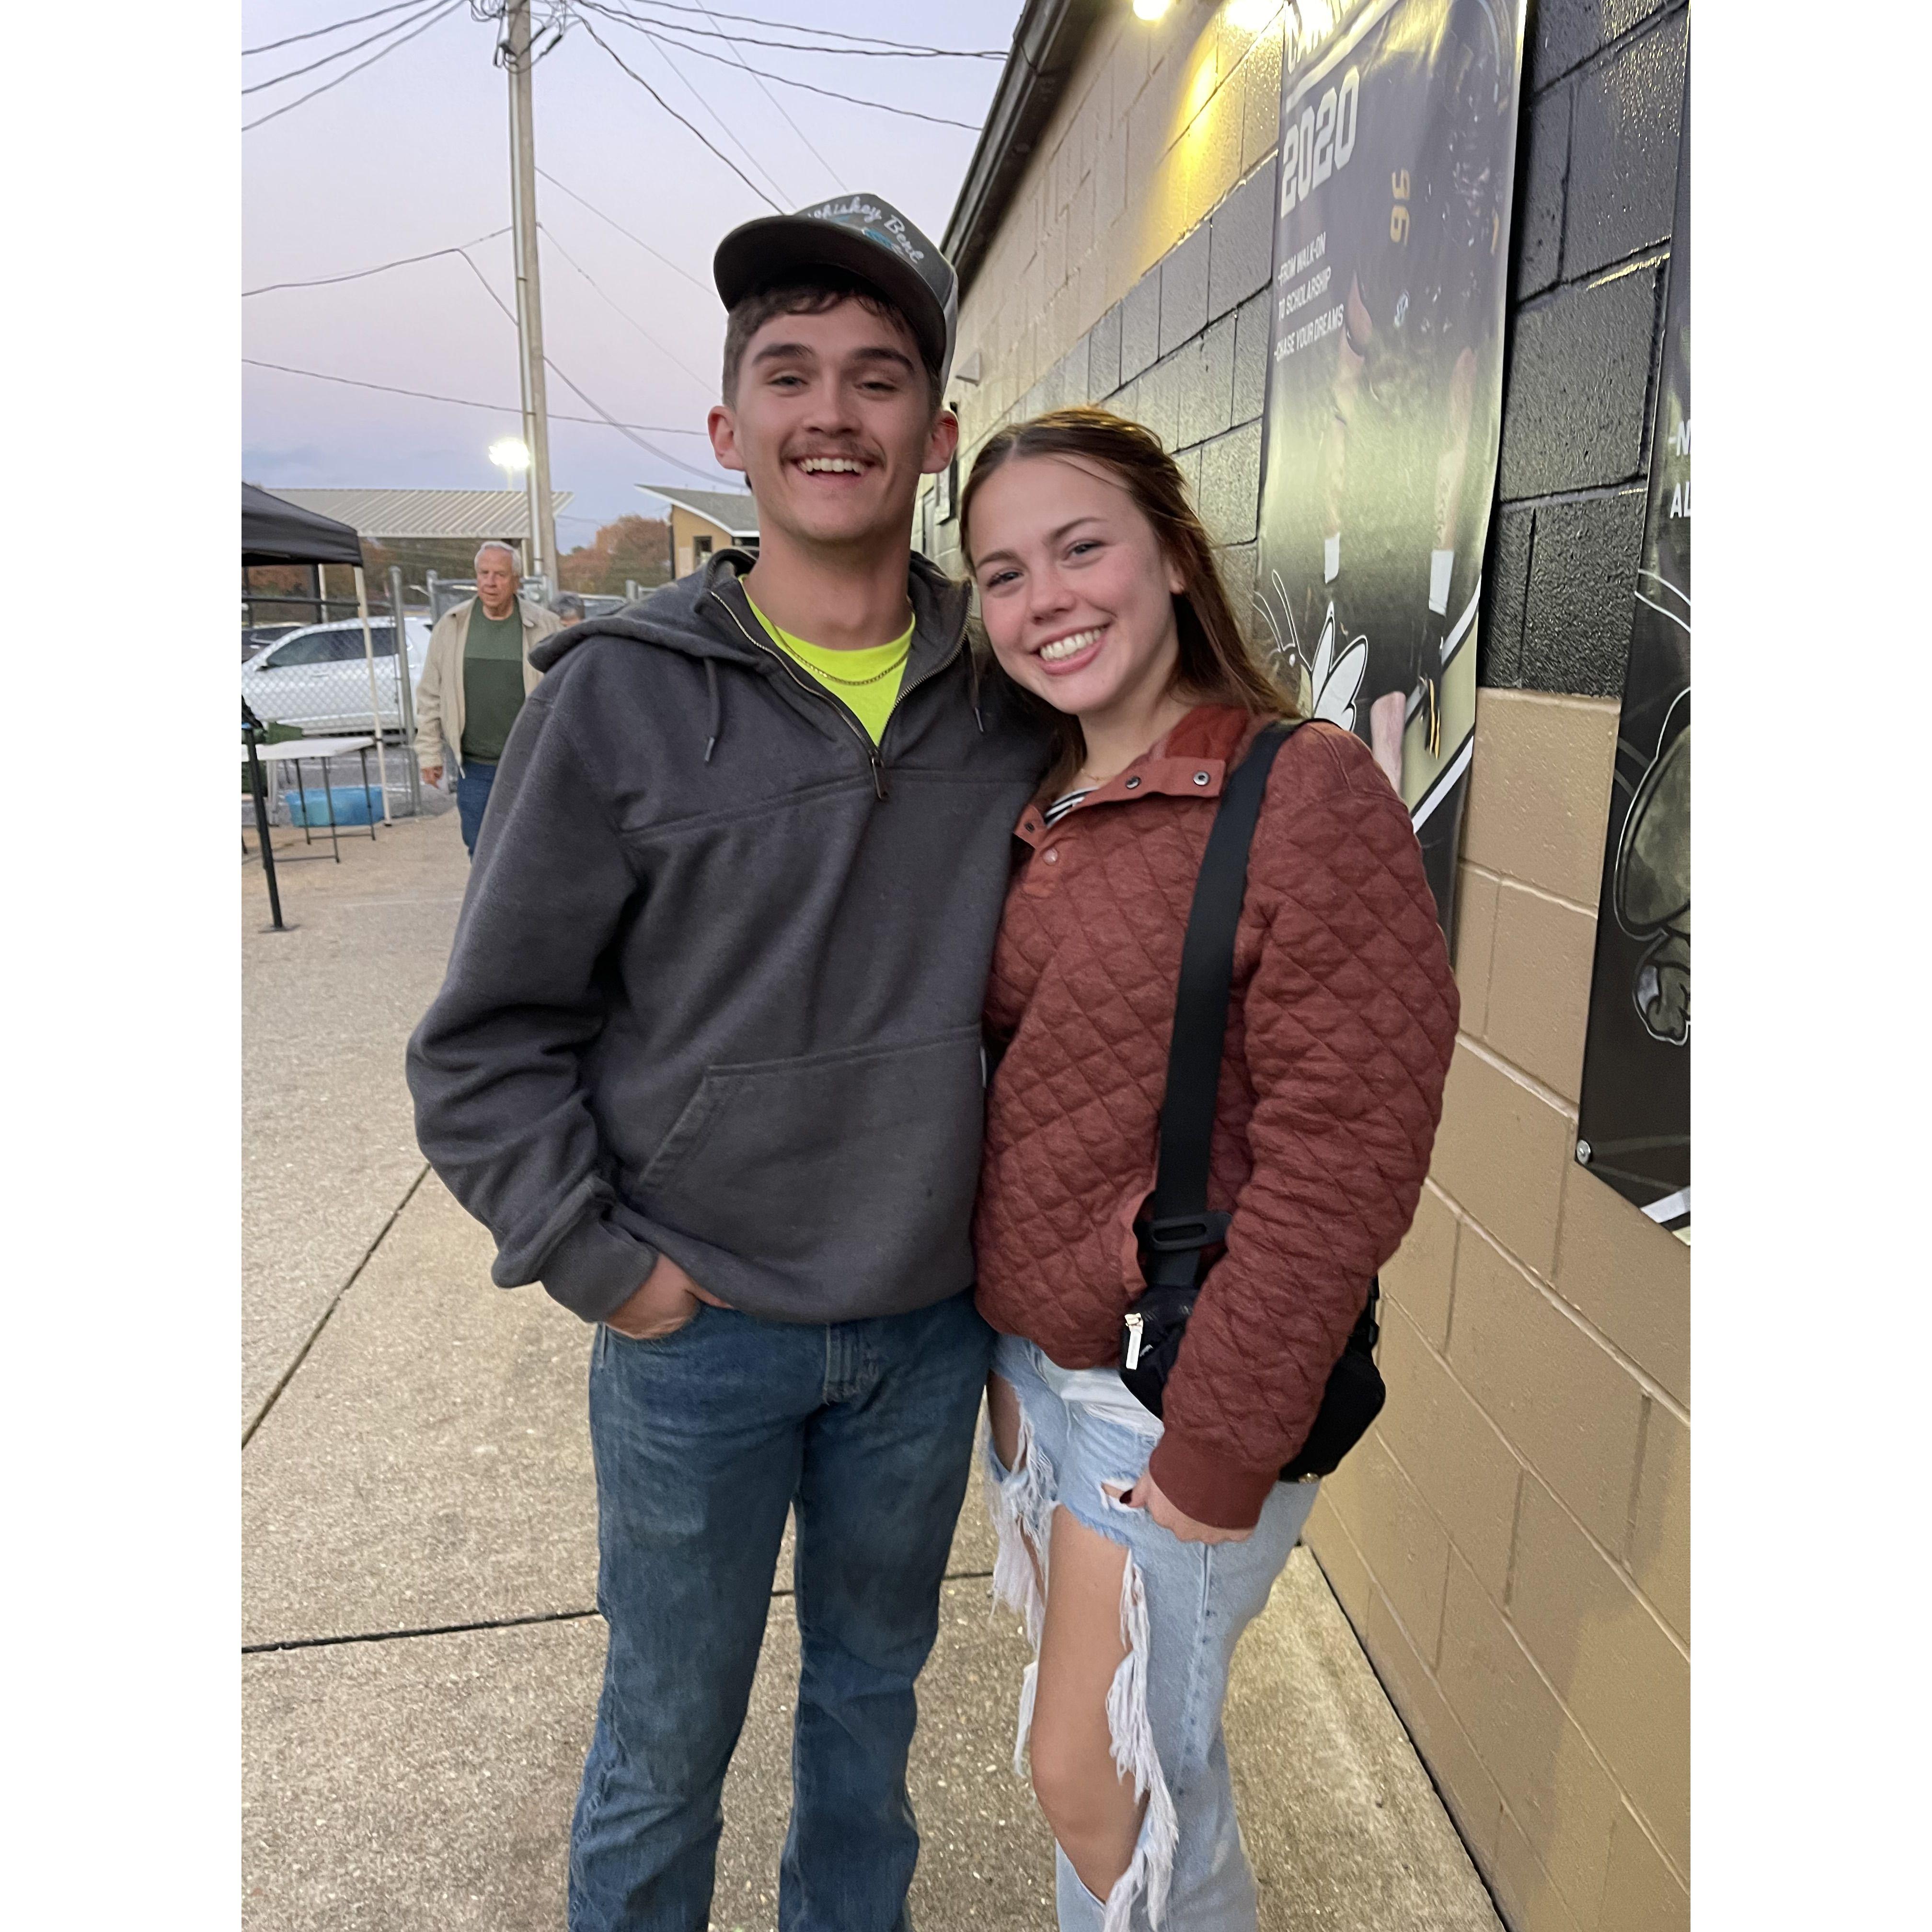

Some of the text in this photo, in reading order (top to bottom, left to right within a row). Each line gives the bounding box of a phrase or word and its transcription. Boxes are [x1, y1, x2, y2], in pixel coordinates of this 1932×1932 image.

[1281, 65, 1359, 218] 2020
[1286, 265, 1331, 315] SCHOLARSHIP
[1296, 321, 1314, 350] YOUR
[1314, 303, 1344, 341] DREAMS
